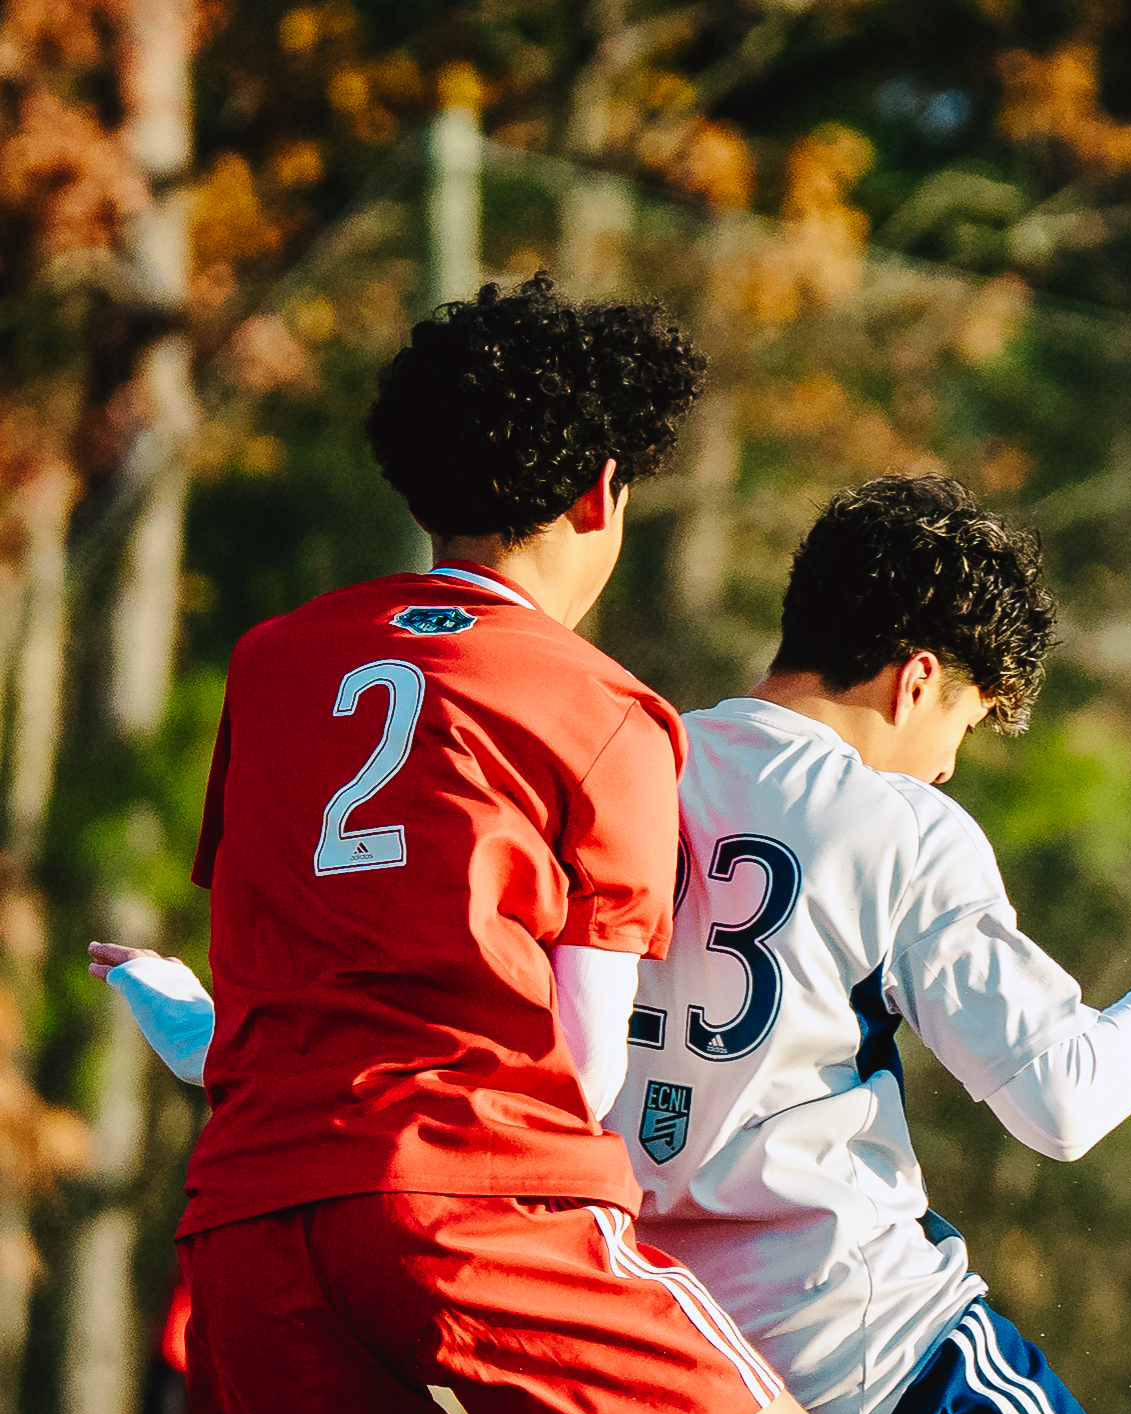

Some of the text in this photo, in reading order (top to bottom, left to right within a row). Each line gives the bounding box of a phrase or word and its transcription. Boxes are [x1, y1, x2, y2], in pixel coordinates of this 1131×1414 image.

[314, 659, 425, 877] 2
[627, 831, 802, 1062] 3
[647, 1084, 688, 1113] ECNL
